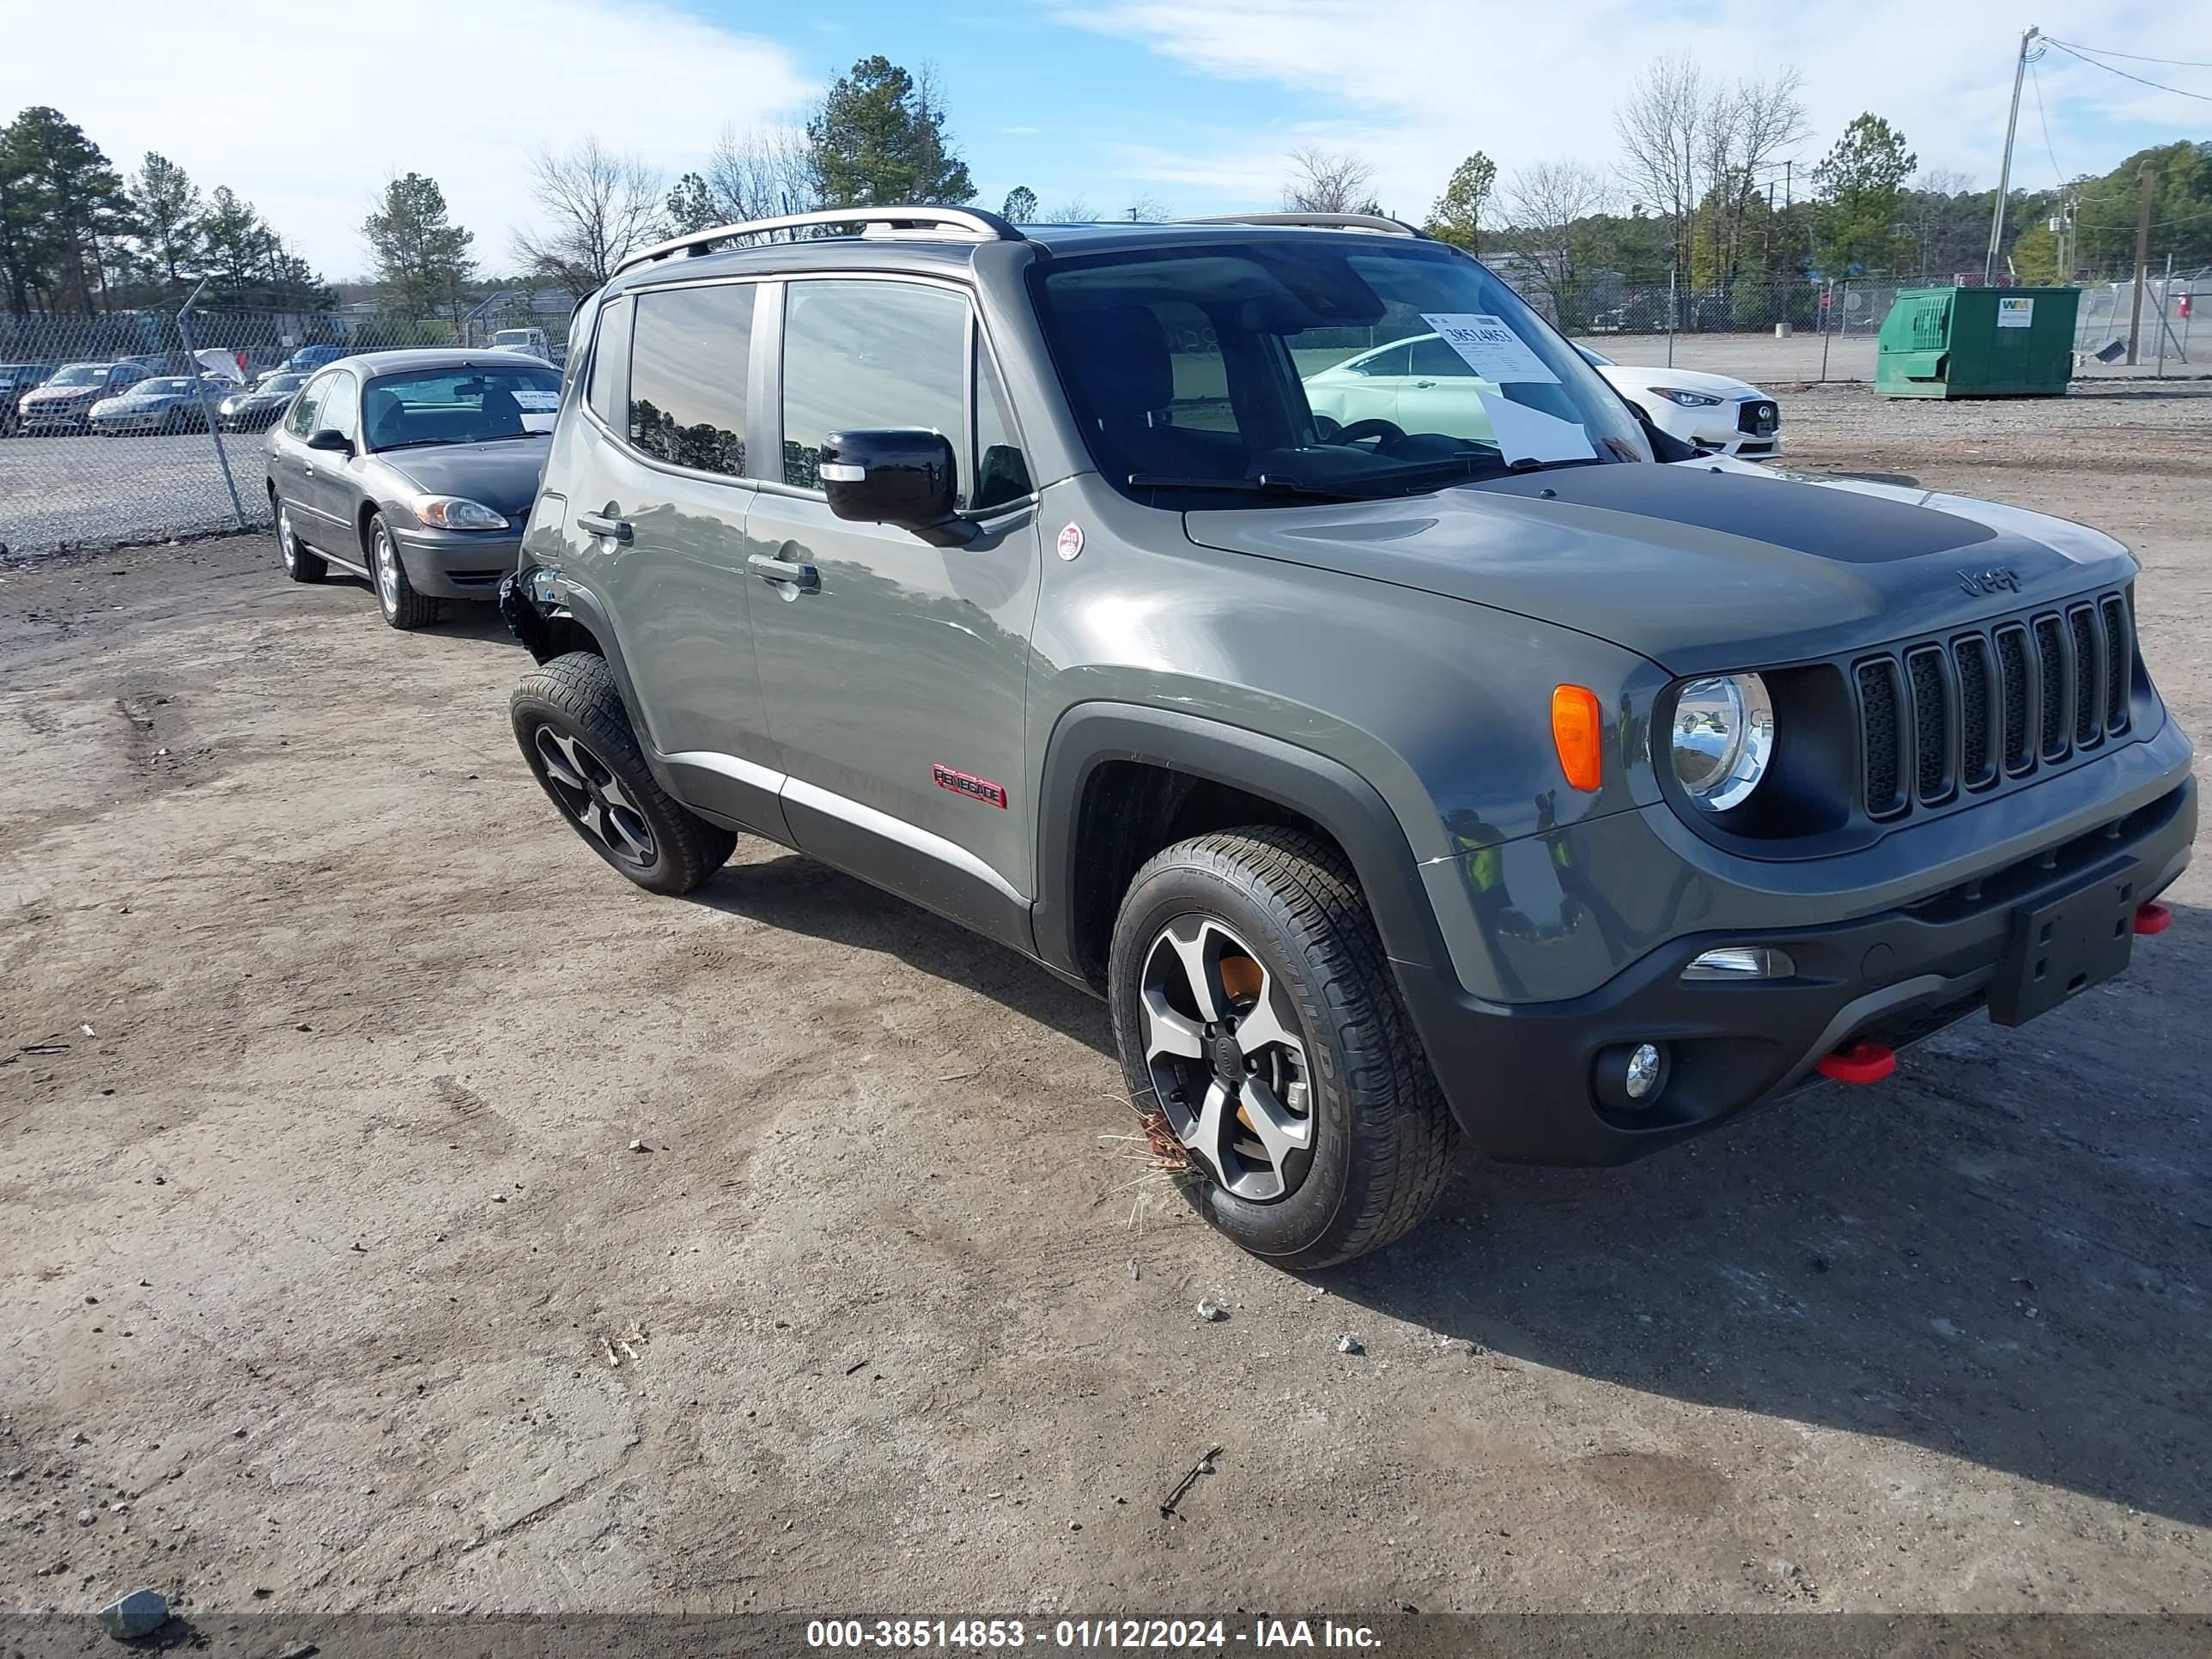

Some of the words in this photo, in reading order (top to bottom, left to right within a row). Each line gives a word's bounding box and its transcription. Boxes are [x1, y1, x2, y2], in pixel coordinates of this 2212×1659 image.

[2002, 301, 2028, 310] WM
[1445, 329, 1513, 343] 38514853
[1956, 566, 2021, 598] Jeep
[934, 768, 1001, 804] RENEGADE
